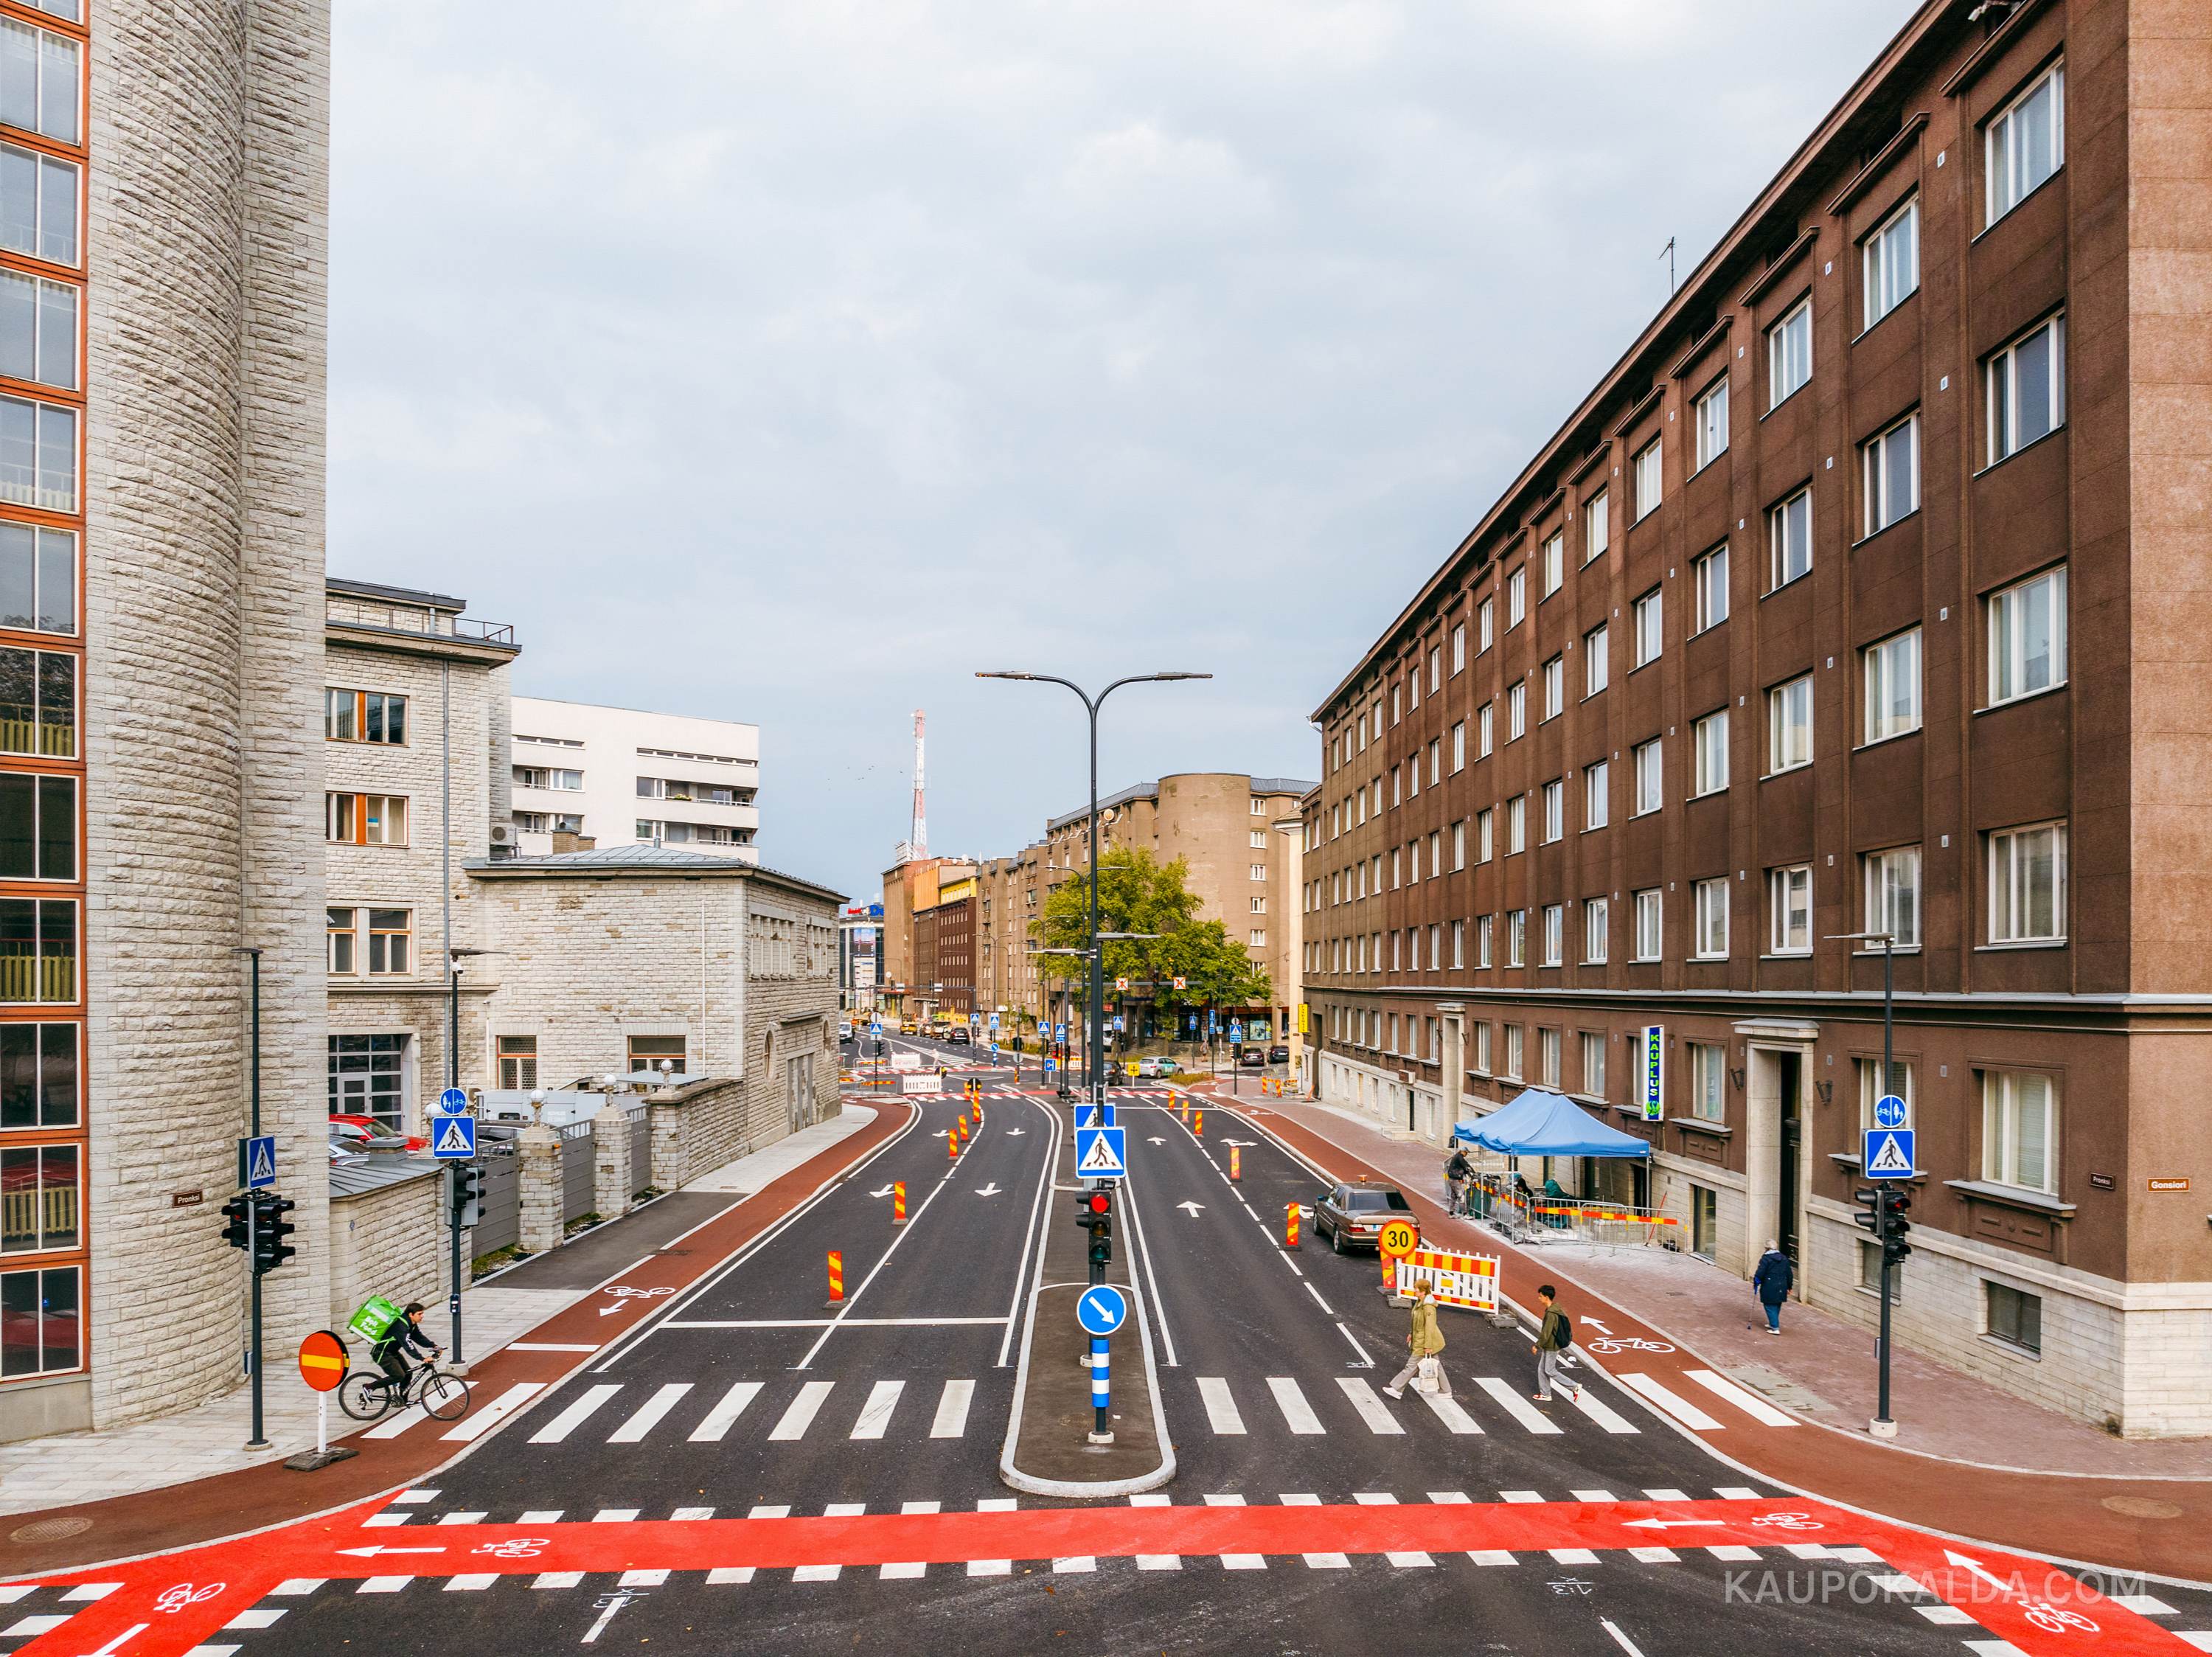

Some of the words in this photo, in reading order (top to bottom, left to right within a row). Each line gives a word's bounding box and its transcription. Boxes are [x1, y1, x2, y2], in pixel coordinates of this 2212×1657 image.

[1649, 1034, 1660, 1097] KAUPLUS
[2092, 1175, 2110, 1185] Pronksi
[2151, 1181, 2187, 1189] Gonsiori
[177, 1194, 201, 1204] Pronksi
[1388, 1230, 1409, 1248] 30
